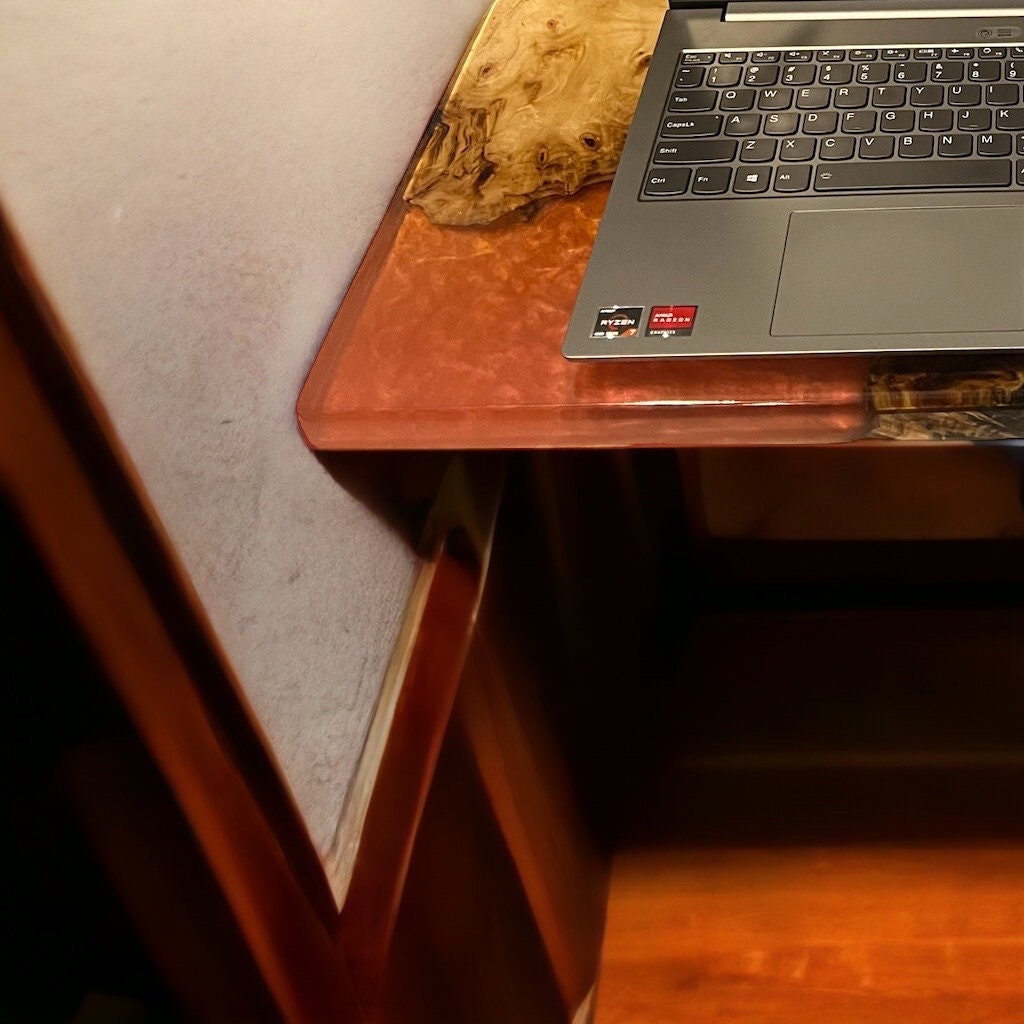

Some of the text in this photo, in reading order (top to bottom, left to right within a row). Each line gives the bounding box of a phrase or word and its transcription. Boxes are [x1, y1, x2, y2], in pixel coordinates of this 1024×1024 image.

[785, 74, 794, 82] 3
[823, 73, 830, 81] 4
[860, 72, 868, 81] 5
[897, 71, 905, 80] 6
[935, 71, 943, 79] 7
[971, 70, 980, 78] 8
[1009, 70, 1017, 78] 9
[747, 75, 756, 83] 2
[725, 90, 737, 99] Q
[764, 90, 778, 98] W
[801, 89, 811, 97] E
[839, 88, 849, 96] R
[877, 87, 886, 95] T
[915, 86, 925, 95] Y
[952, 86, 962, 95] U
[807, 113, 818, 122] D
[846, 112, 855, 121] F
[885, 111, 896, 120] G
[923, 111, 934, 119] H
[961, 110, 970, 119] J
[1000, 109, 1009, 118] K
[730, 115, 740, 124] A
[769, 114, 779, 123] S
[785, 139, 795, 148] X
[825, 138, 836, 148] C
[865, 137, 875, 146] V
[903, 136, 913, 146] B
[942, 136, 953, 144] N
[981, 135, 993, 144] M
[745, 140, 756, 150] Z
